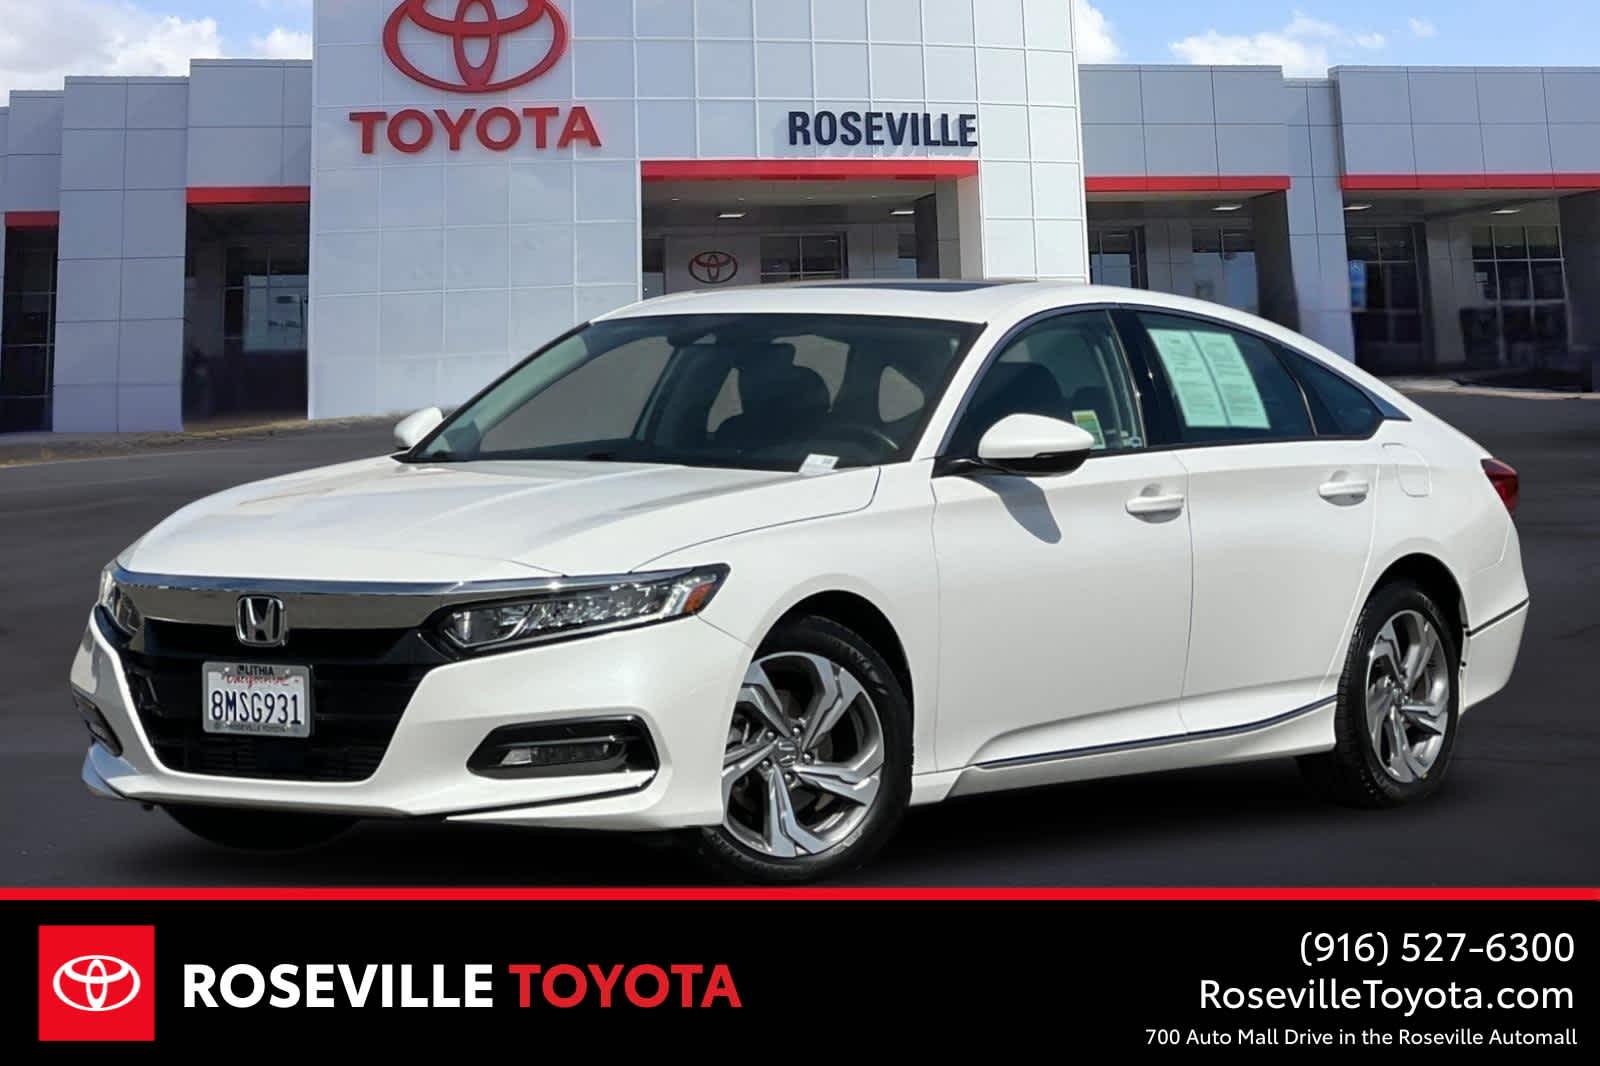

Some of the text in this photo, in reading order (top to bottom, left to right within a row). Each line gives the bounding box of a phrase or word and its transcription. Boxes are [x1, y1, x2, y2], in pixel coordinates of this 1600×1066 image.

[349, 106, 602, 154] TOYOTA
[788, 111, 978, 148] ROSEVILLE
[211, 690, 301, 725] 8MSG931
